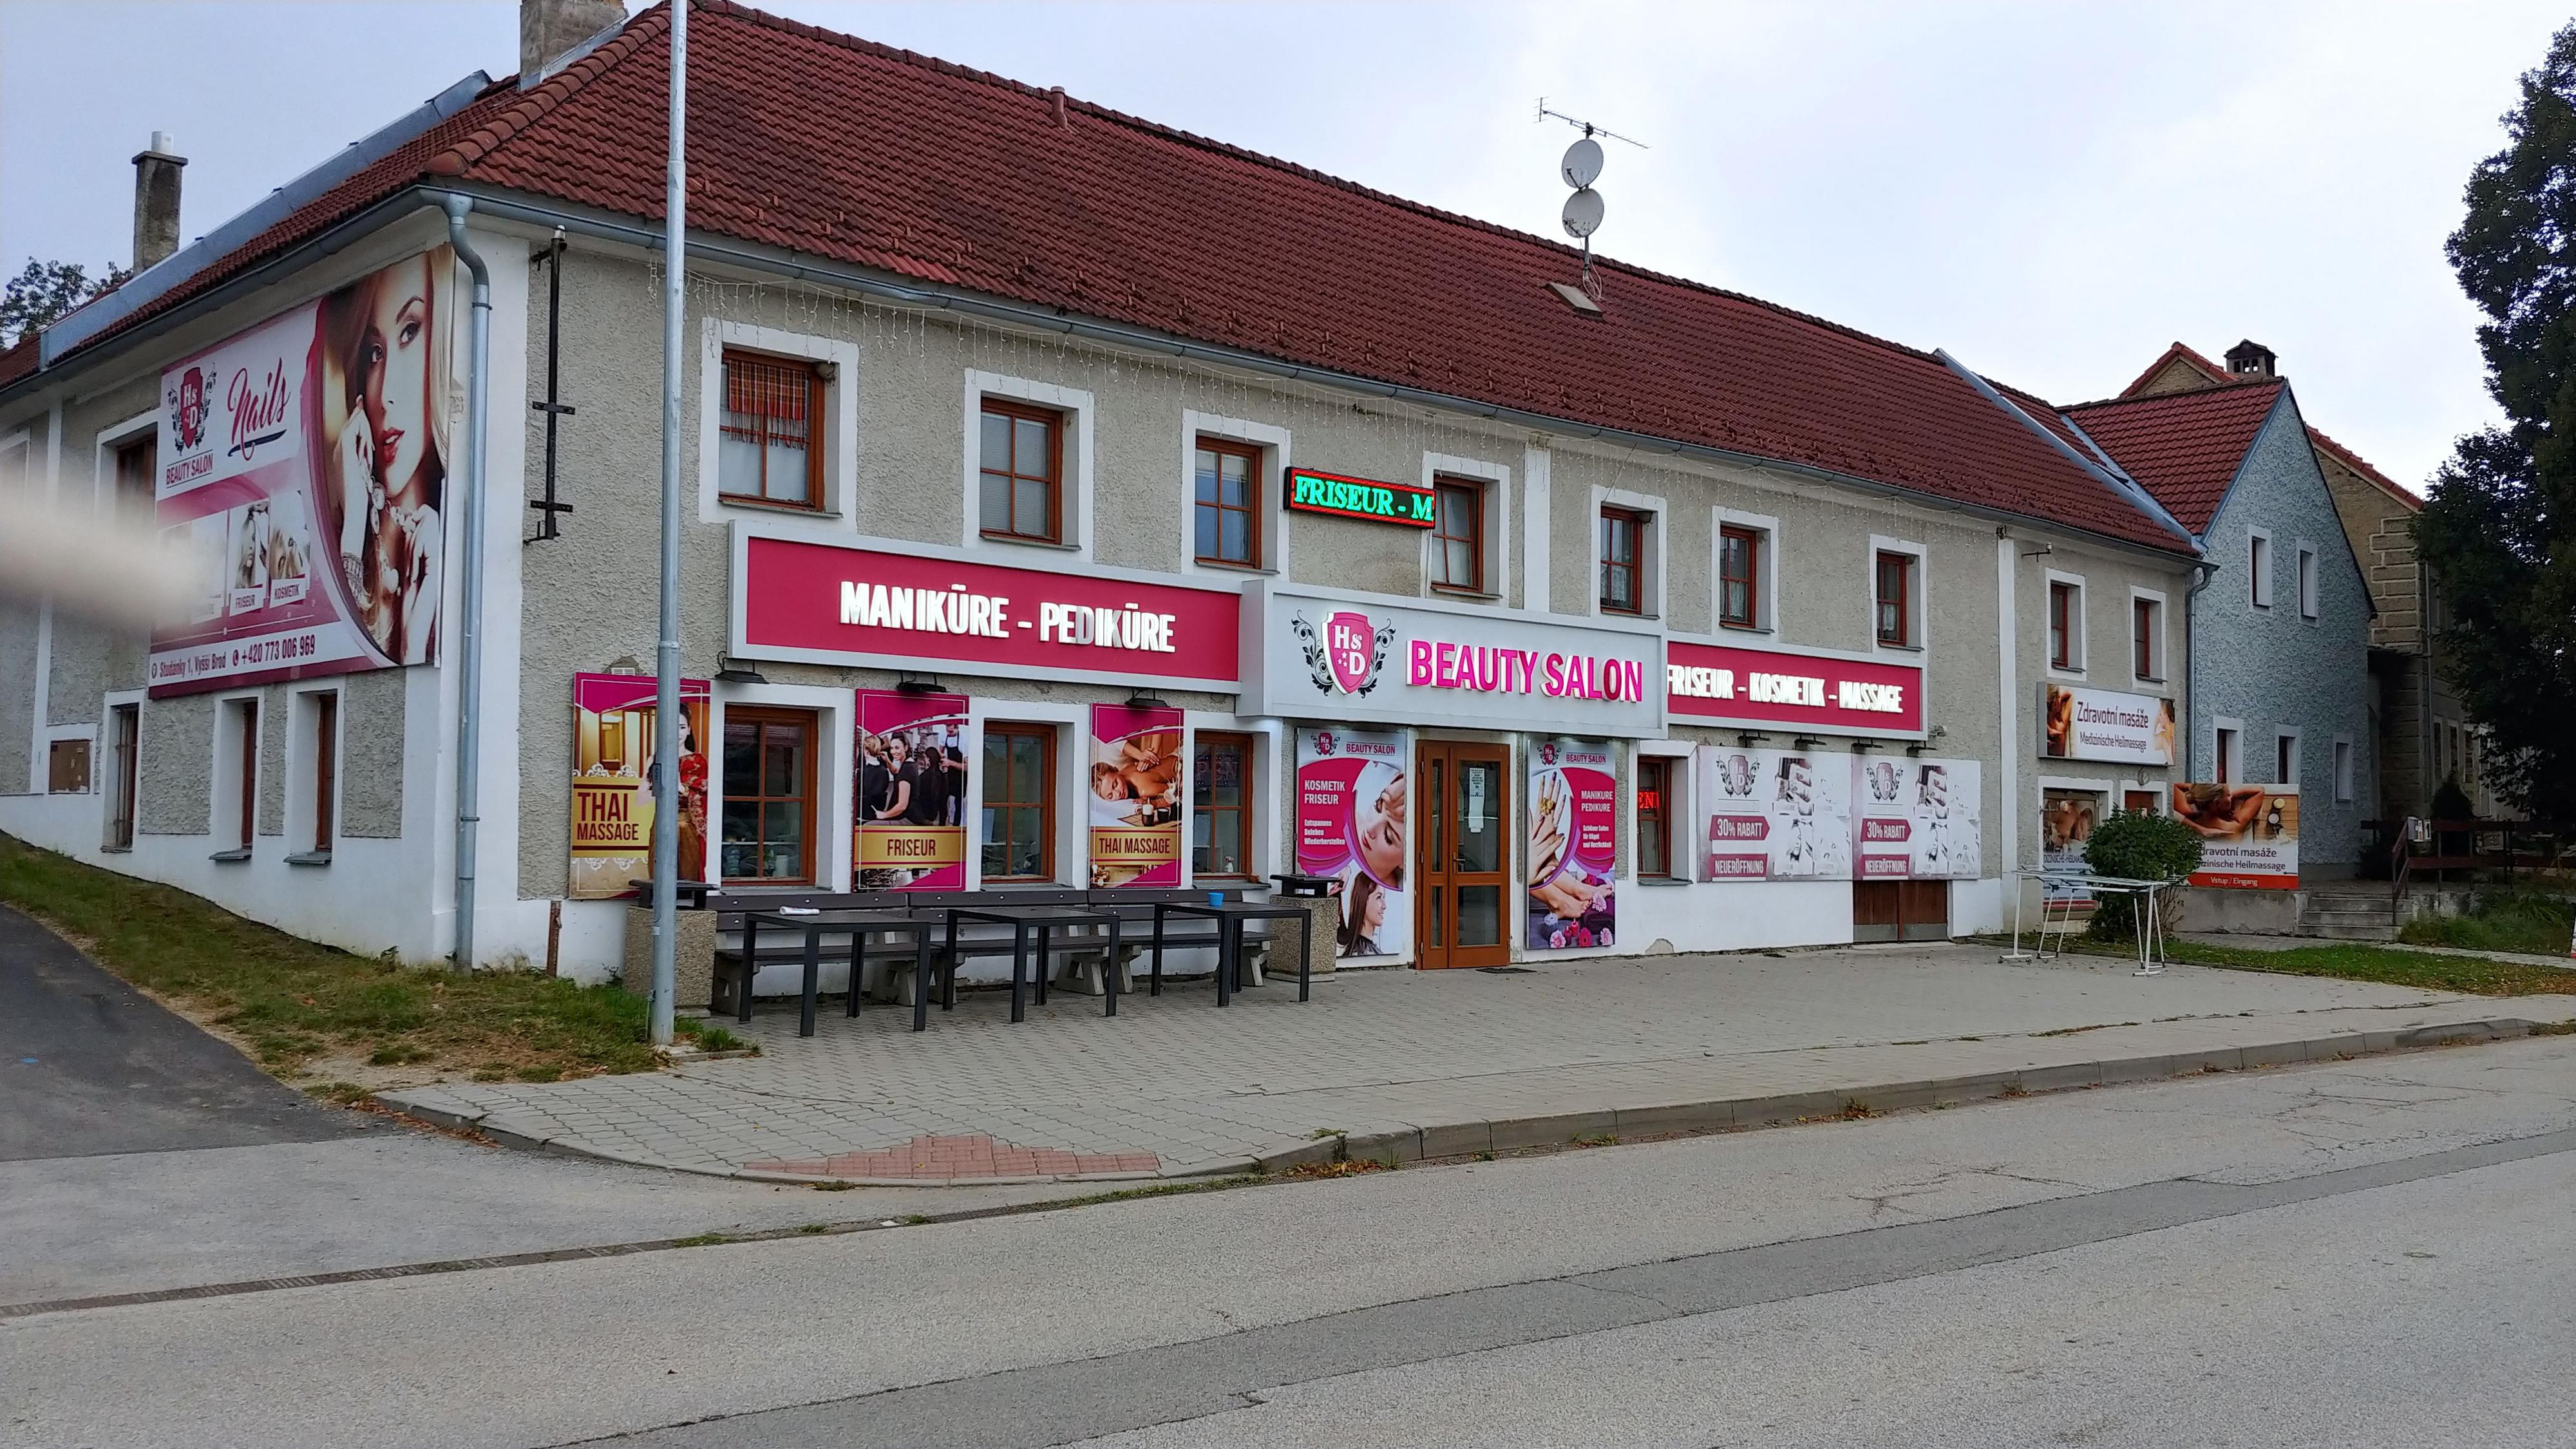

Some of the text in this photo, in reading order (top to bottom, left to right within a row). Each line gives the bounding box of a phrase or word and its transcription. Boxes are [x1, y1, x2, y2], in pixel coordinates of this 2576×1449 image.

[227, 357, 290, 461] Nails
[166, 453, 213, 485] BEAUTY SALON
[1294, 475, 1394, 516] FRISEUR
[1411, 494, 1434, 521] M
[274, 583, 299, 600] KOSMETIK
[236, 594, 255, 609] FRISEUR
[840, 581, 1010, 639] MANIKÜRE
[1039, 602, 1176, 653] PEDIKÜRE
[212, 651, 226, 670] Brod
[242, 641, 263, 665] +420
[265, 640, 279, 661] 773
[282, 637, 298, 659] 006
[299, 634, 316, 656] 969
[1349, 651, 1366, 676] D
[1406, 639, 1643, 703] BEAUTY SALON
[1667, 664, 1734, 699] FRISEUR
[1749, 672, 1826, 707] KOSMETIK
[1839, 681, 1903, 714] MASSAGE
[2077, 701, 2149, 729] Zdravotní masáže
[1346, 743, 1396, 754] BEAUTY SALON
[2079, 731, 2147, 753] Medizinische Heilmassage
[1566, 754, 1606, 763] BEAUTY SALON
[1304, 780, 1345, 791] KOSMETIK
[1304, 793, 1339, 804] FRISEUR
[1581, 790, 1613, 800] MANIKURE
[577, 792, 628, 822] THAI
[1581, 803, 1611, 812] PEDIKURE
[577, 823, 639, 840] MASSAGE
[1717, 819, 1763, 837] 30% RABATT
[1867, 822, 1906, 838] 30% RABATT
[887, 838, 936, 856] FRISEUR
[1099, 838, 1171, 854] THAI MASSAGE
[2201, 846, 2277, 858] dravotní masáže
[1715, 857, 1764, 874] NEUERÖFFNUNG
[1865, 858, 1906, 873] NEUERÖFFNUNG
[2235, 860, 2286, 871] Heilmassage
[2210, 876, 2228, 885] Vstup
[2233, 878, 2259, 887] Eingang
